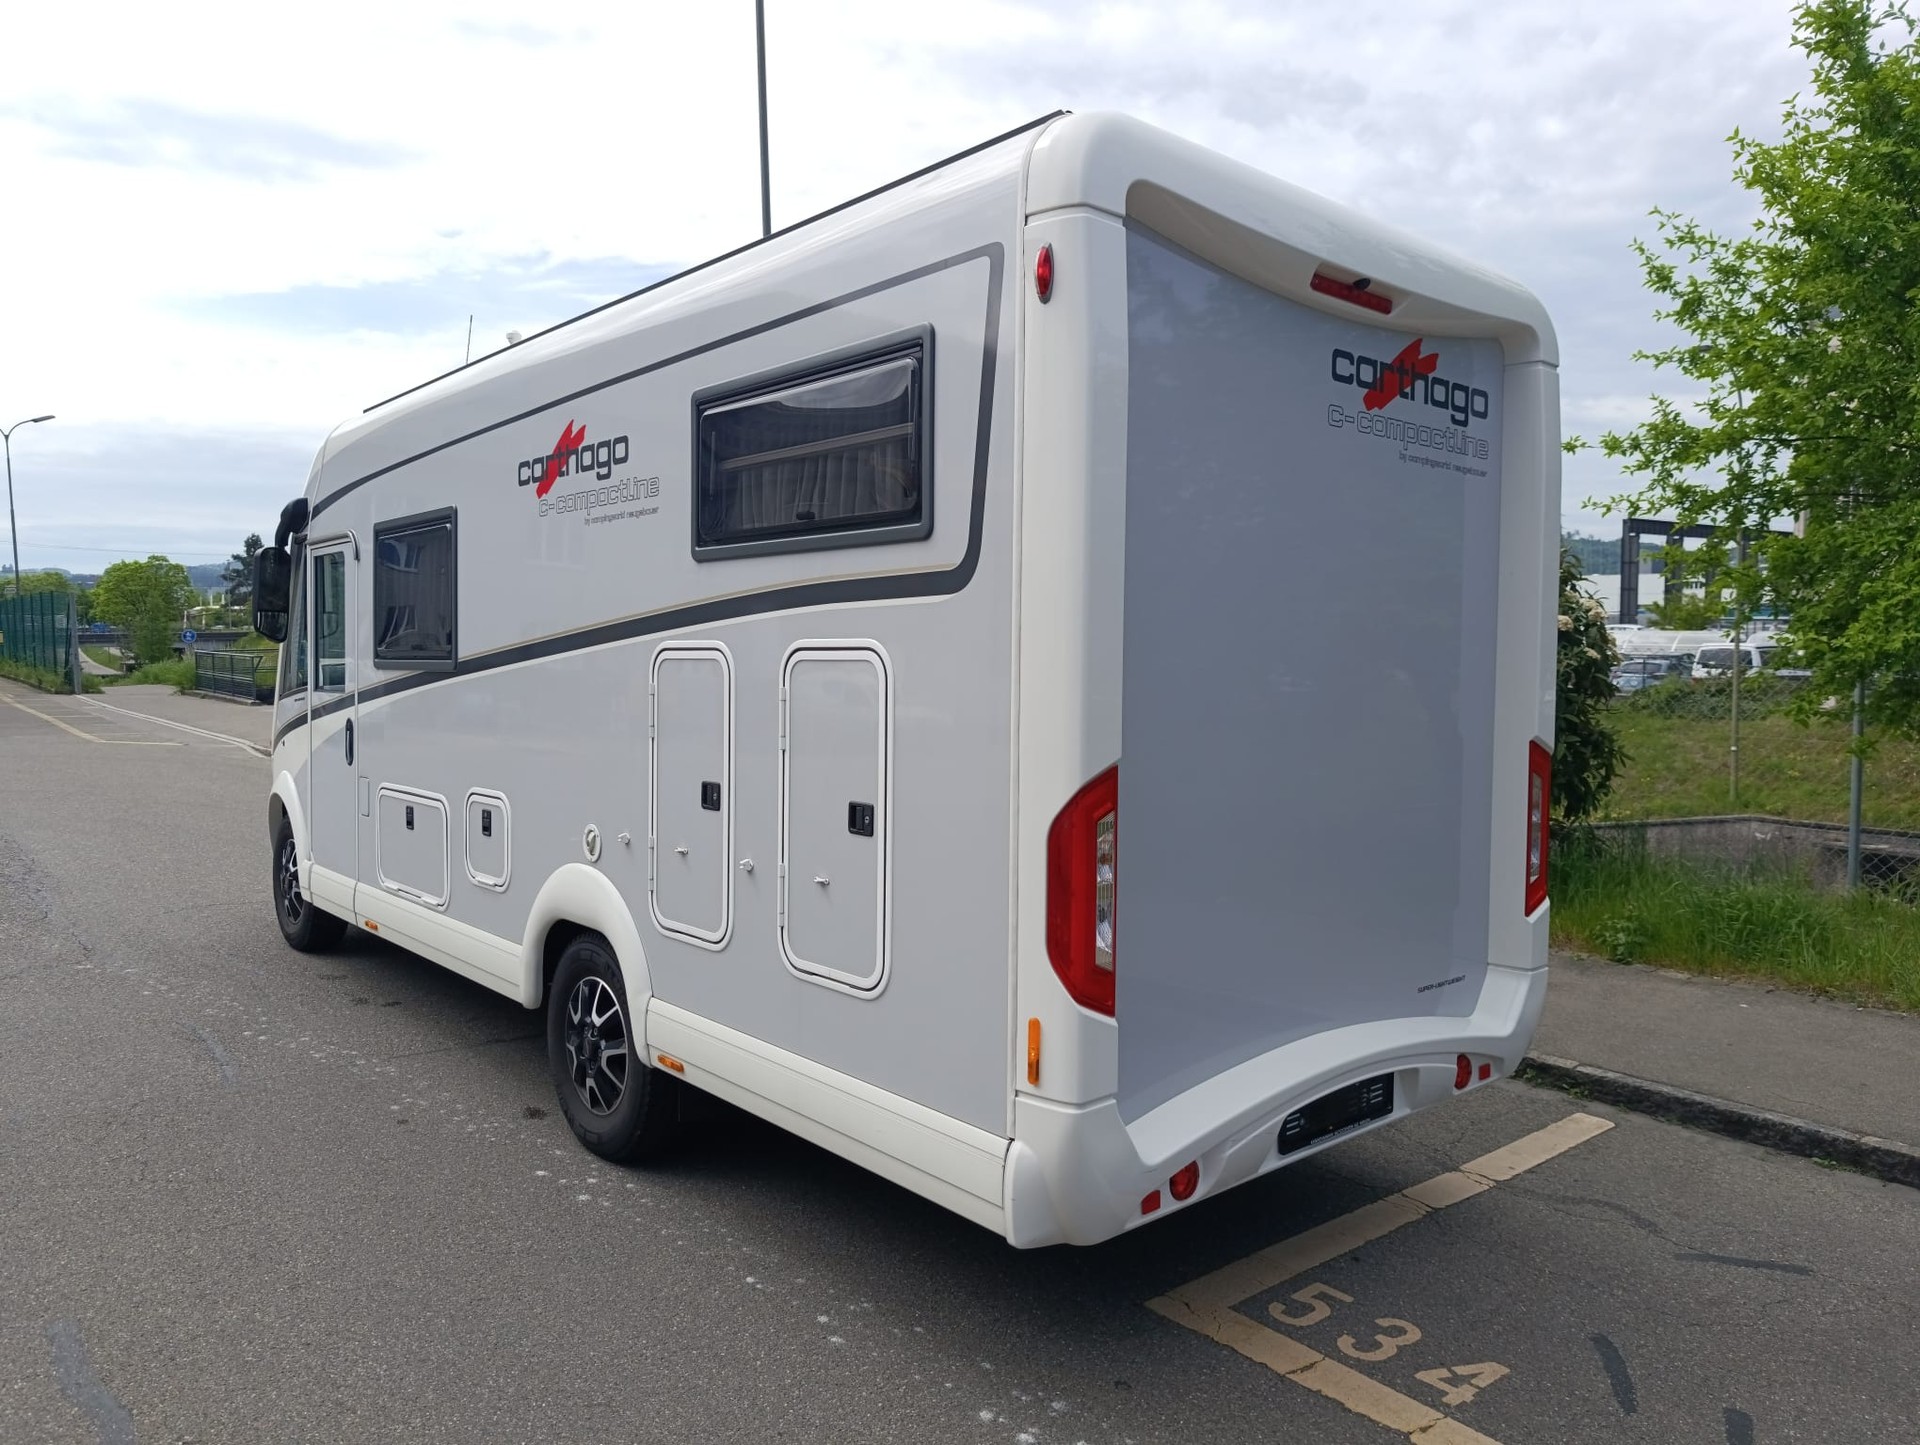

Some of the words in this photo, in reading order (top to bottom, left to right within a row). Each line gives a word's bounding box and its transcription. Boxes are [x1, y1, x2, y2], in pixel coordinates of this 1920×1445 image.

[1332, 348, 1489, 428] carthago
[518, 435, 629, 487] carthago
[1268, 1282, 1511, 1406] 534
